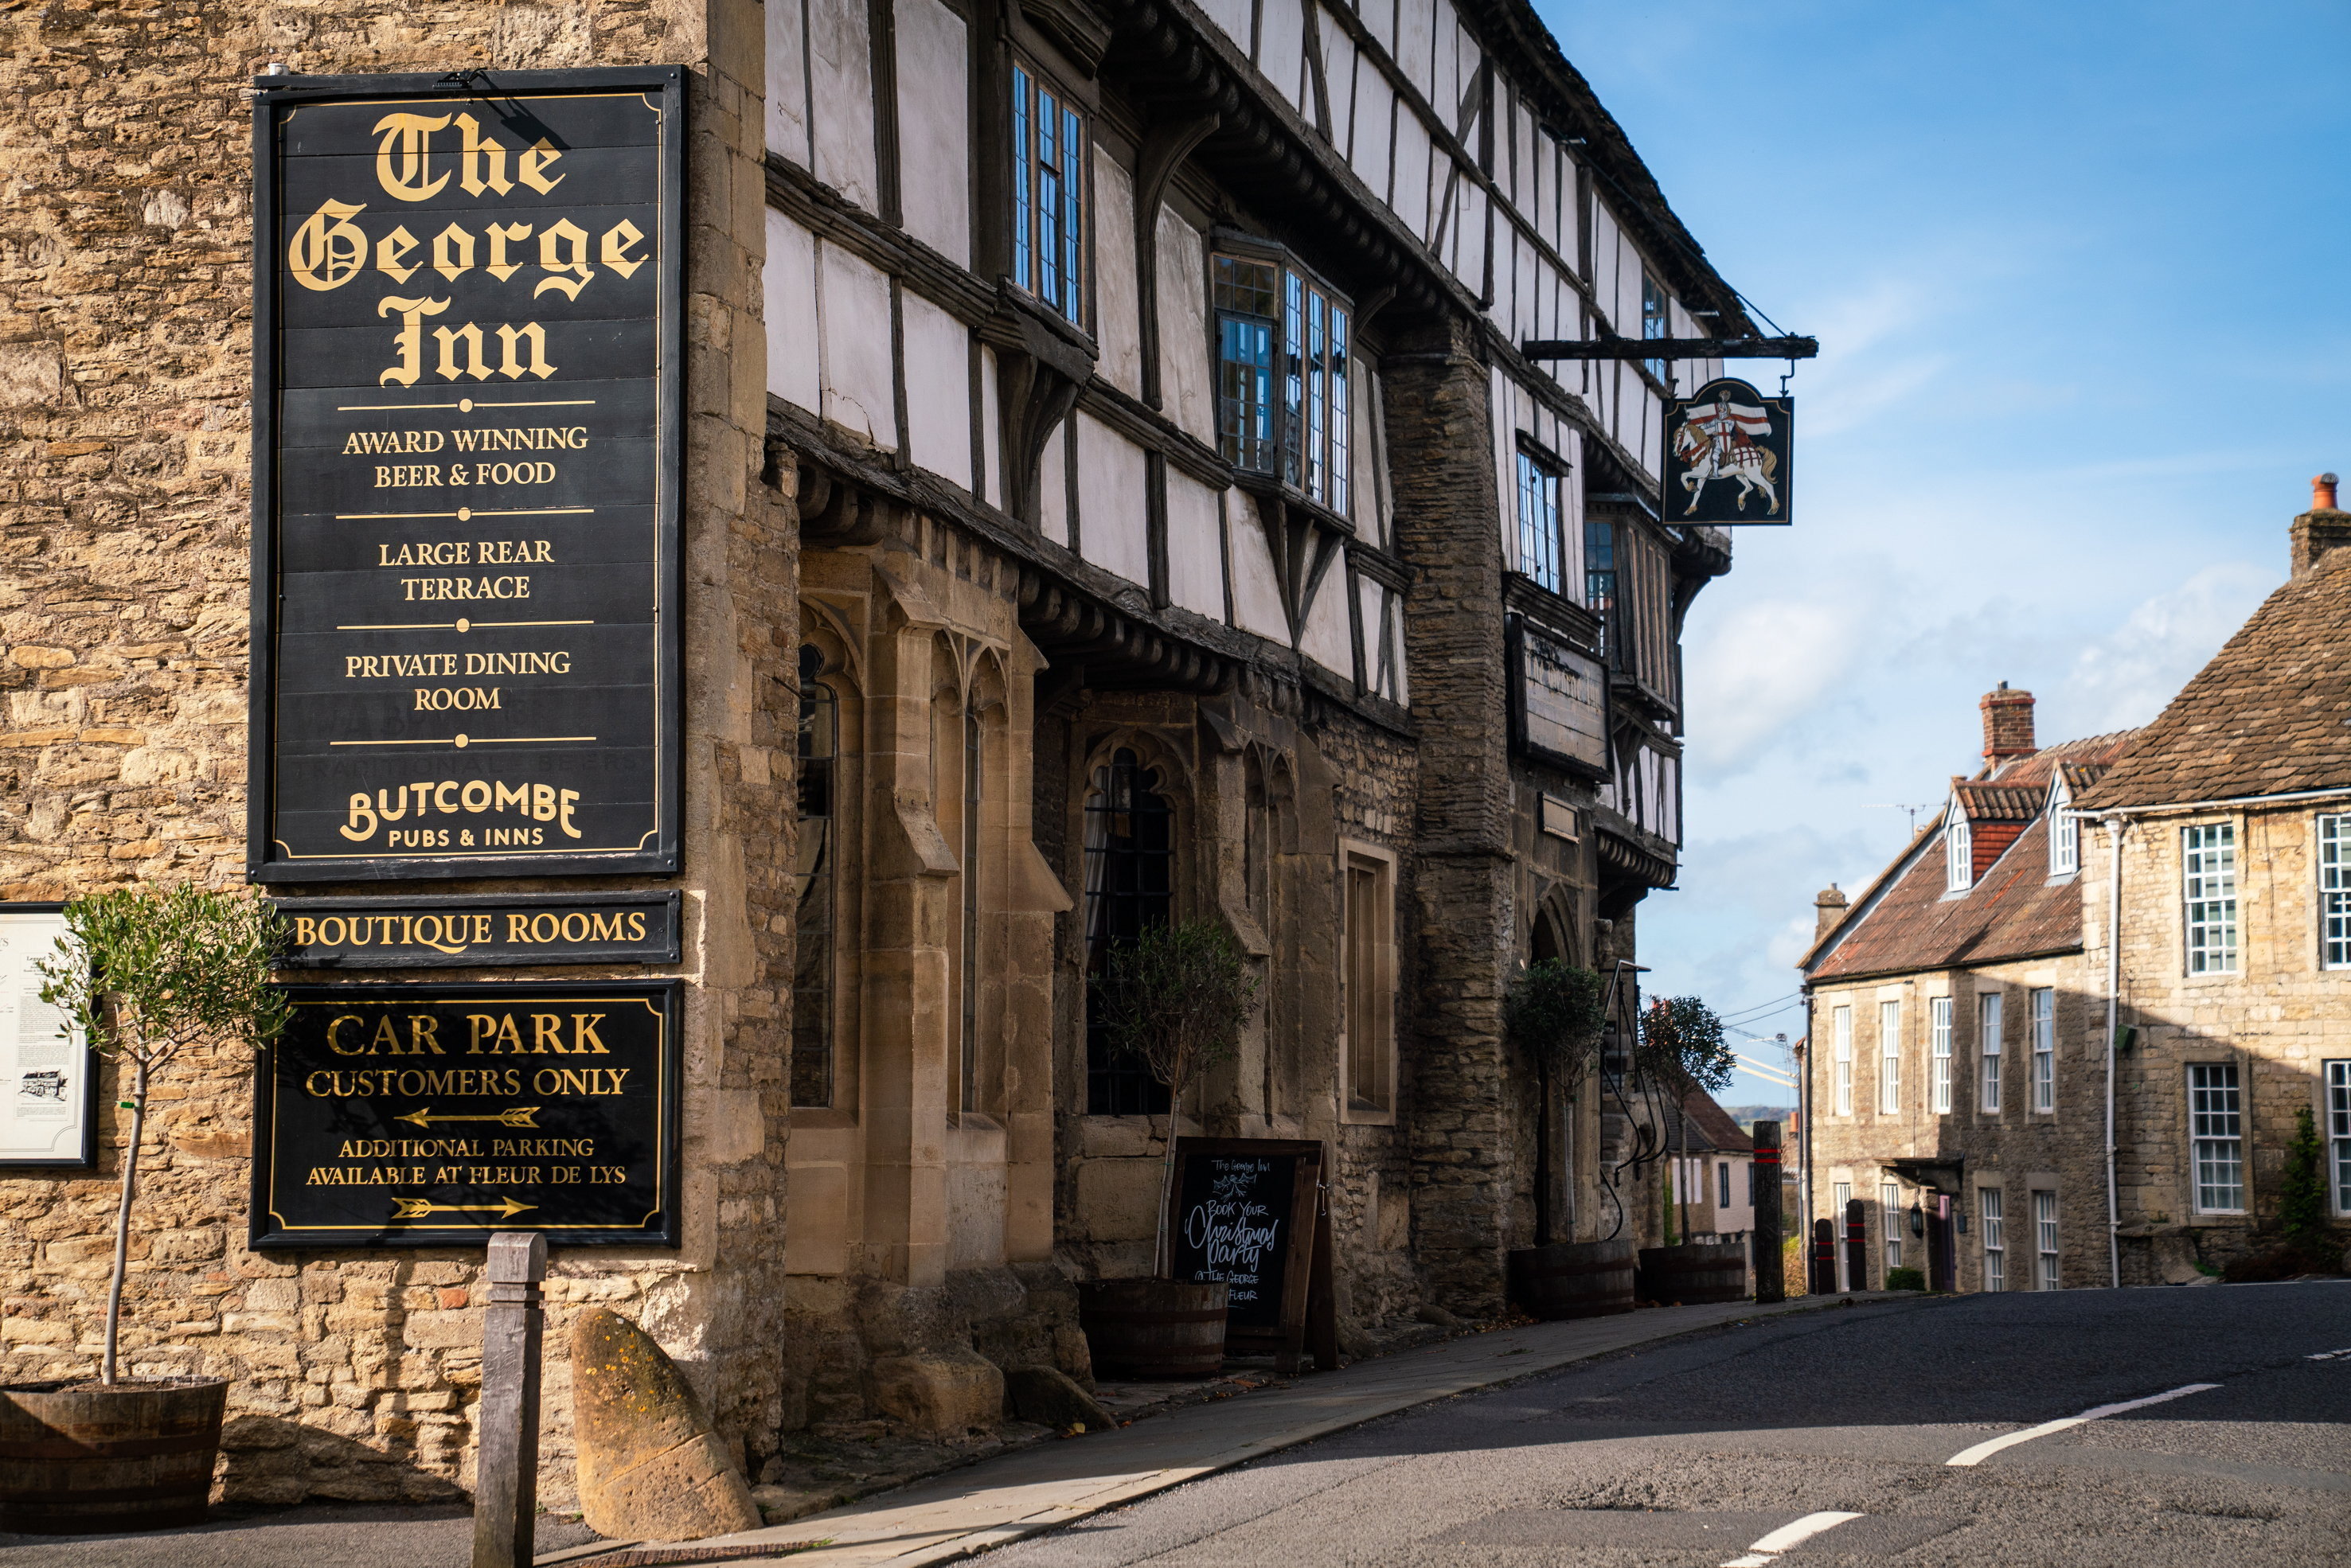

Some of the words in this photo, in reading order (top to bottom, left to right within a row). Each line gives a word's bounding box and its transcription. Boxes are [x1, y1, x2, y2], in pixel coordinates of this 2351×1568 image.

[371, 111, 567, 202] The
[287, 197, 650, 302] George
[377, 295, 558, 389] Inn
[342, 430, 445, 454] AWARD
[450, 426, 589, 452] WINNING
[373, 464, 444, 488] BEER
[448, 463, 471, 486] &
[475, 462, 557, 486] FOOD
[378, 541, 471, 567] LARGE
[477, 540, 556, 564] REAR
[400, 575, 530, 601] TERRACE
[345, 653, 458, 678] PRIVATE
[464, 650, 572, 676] DINING
[413, 687, 502, 711] ROOM
[339, 779, 582, 842] BUTCOMBE
[389, 829, 450, 848] PUBS
[459, 829, 475, 847] &
[485, 827, 544, 846] INNS
[295, 914, 493, 955] BOUTIQUE
[506, 911, 646, 943] ROOMS
[326, 1014, 447, 1055] CAR
[466, 1012, 611, 1055] PARK
[306, 1068, 521, 1098] CUSTOMERS
[533, 1068, 631, 1096] ONLY
[338, 1139, 485, 1158] ADDITIONAL
[492, 1138, 595, 1156] PARKING
[305, 1166, 427, 1186] AVAILABLE
[433, 1165, 463, 1184] AT
[468, 1166, 543, 1184] FLEUR
[550, 1166, 581, 1184] DE
[589, 1165, 627, 1184] LYS
[1211, 1160, 1229, 1172] The
[1231, 1159, 1255, 1174] George
[1184, 1204, 1279, 1252] Christmas
[1203, 1270, 1225, 1281] THE
[1226, 1270, 1259, 1285] GEORGE
[1228, 1288, 1259, 1302] FLEUR
